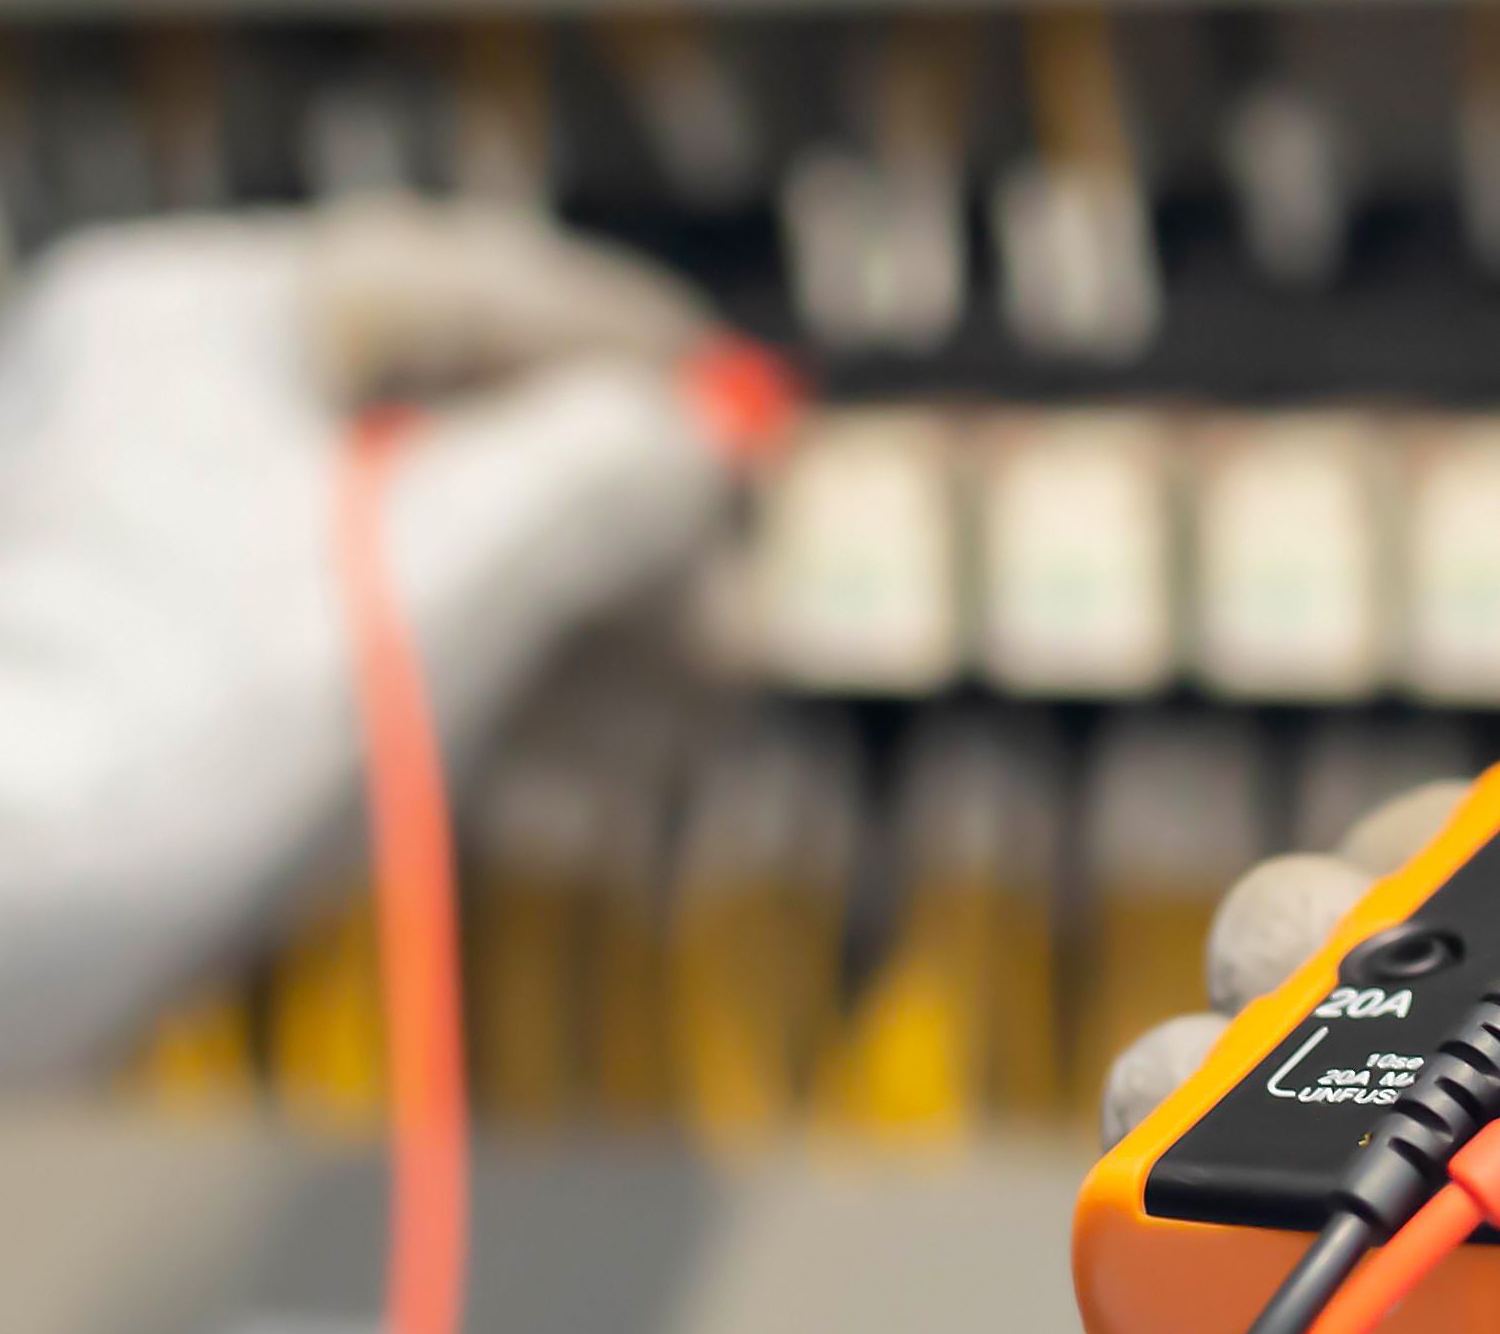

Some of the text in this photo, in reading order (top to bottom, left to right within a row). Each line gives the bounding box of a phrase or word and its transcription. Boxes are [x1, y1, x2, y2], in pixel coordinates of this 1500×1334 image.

[1314, 987, 1412, 1018] 20A
[1317, 1069, 1371, 1086] 20A
[1298, 1087, 1399, 1105] UNFUS
